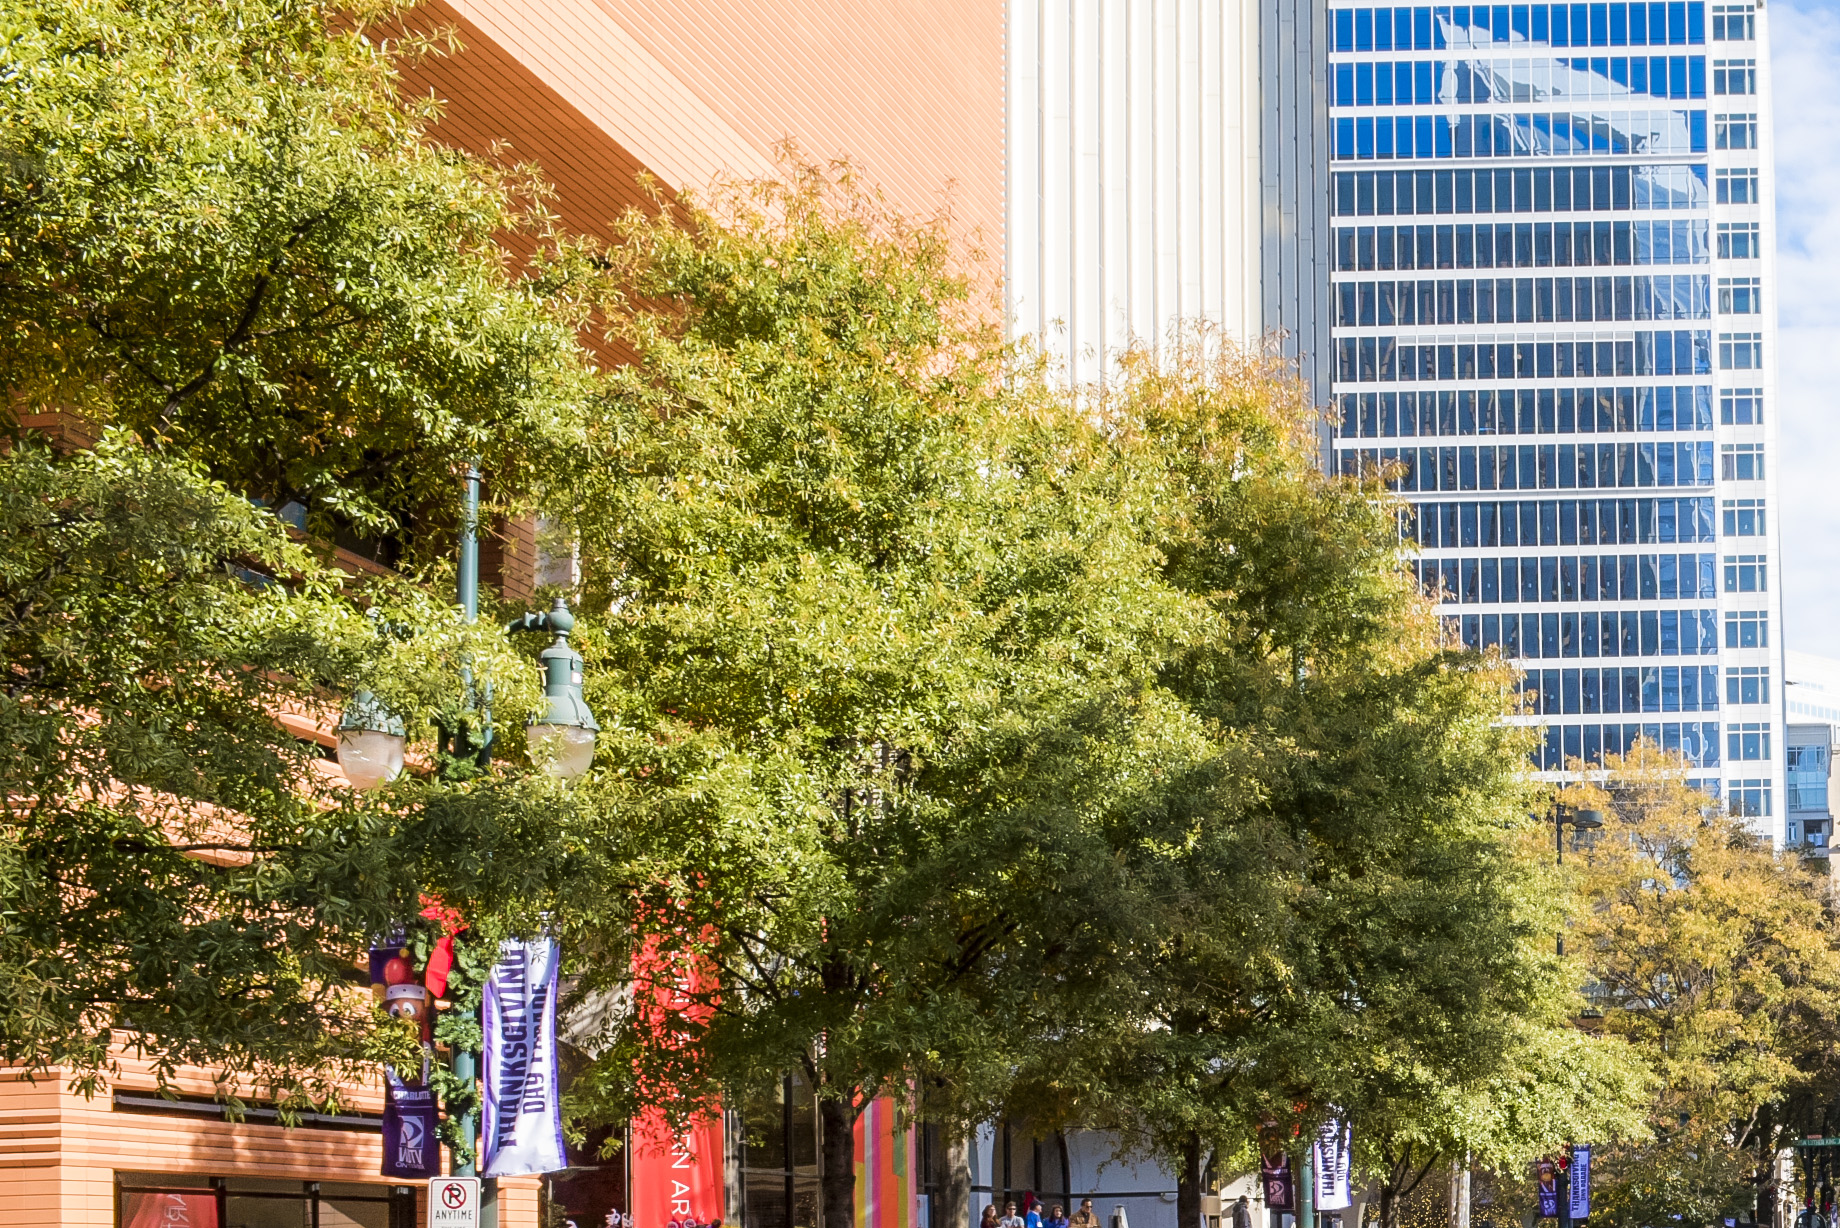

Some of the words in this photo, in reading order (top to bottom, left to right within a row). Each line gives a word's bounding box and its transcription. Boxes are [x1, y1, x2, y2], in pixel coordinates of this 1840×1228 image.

[497, 946, 527, 1152] THANKSGIVING
[523, 1071, 545, 1113] DAY
[1571, 1153, 1580, 1212] THANKSGIVING
[435, 1210, 472, 1219] ANYTIME
